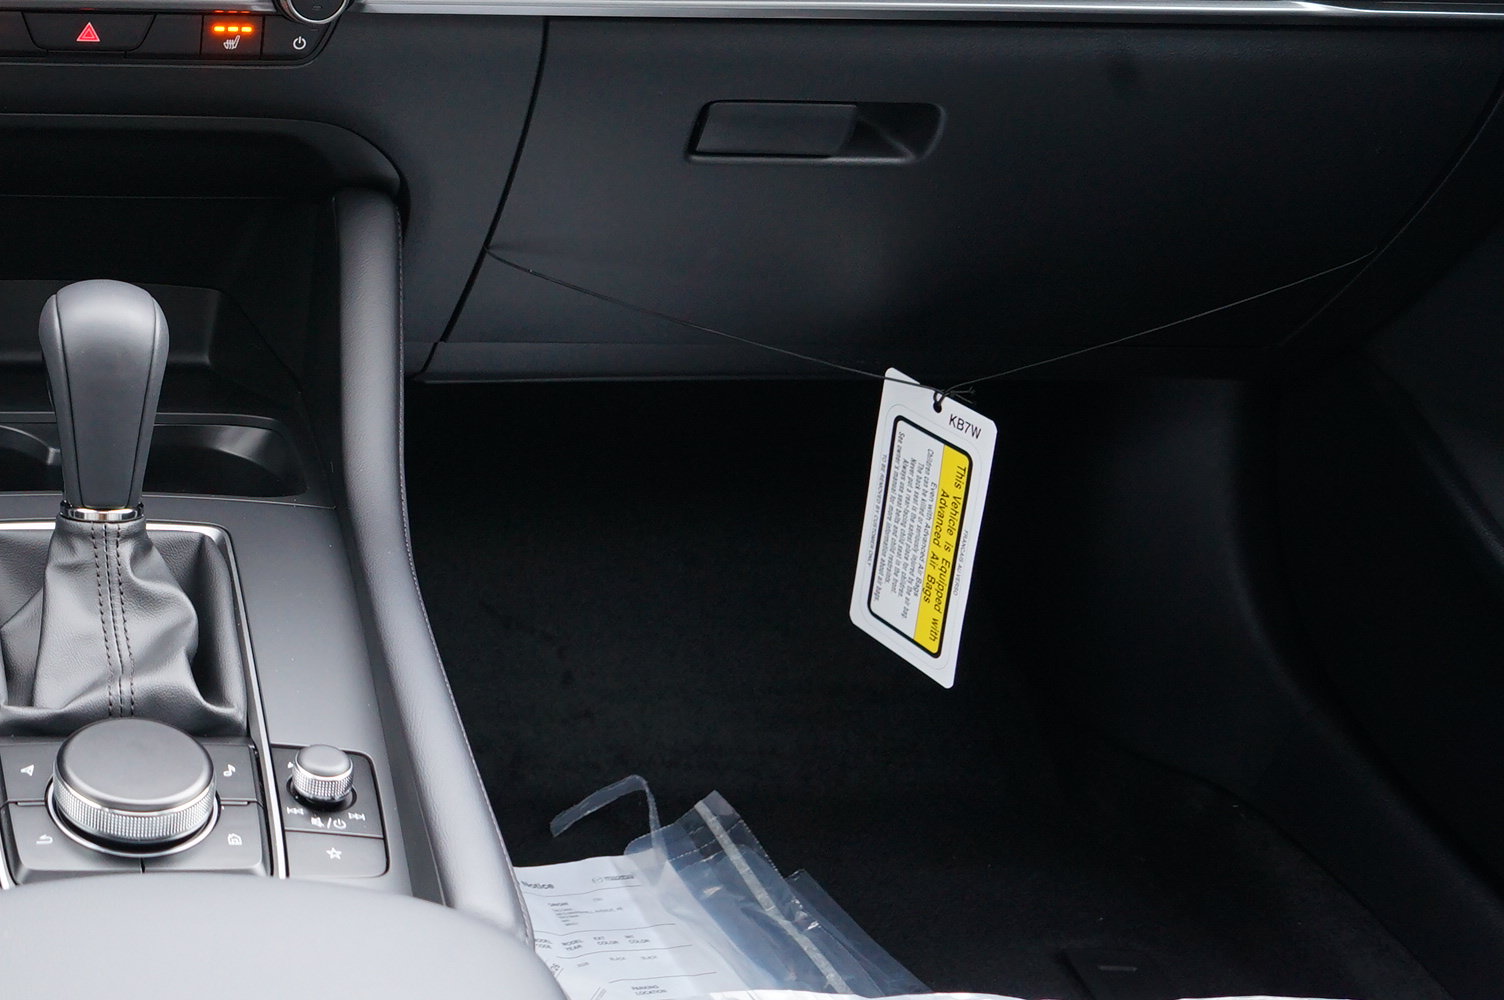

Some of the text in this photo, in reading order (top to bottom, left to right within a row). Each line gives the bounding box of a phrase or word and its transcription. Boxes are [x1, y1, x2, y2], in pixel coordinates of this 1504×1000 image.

[948, 413, 981, 440] KB7W
[929, 481, 937, 502] Even
[919, 522, 930, 562] Advanced
[922, 489, 949, 603] Advanced Air Bags
[929, 466, 966, 641] This Vehicle is Equipped with
[913, 576, 922, 596] Bags
